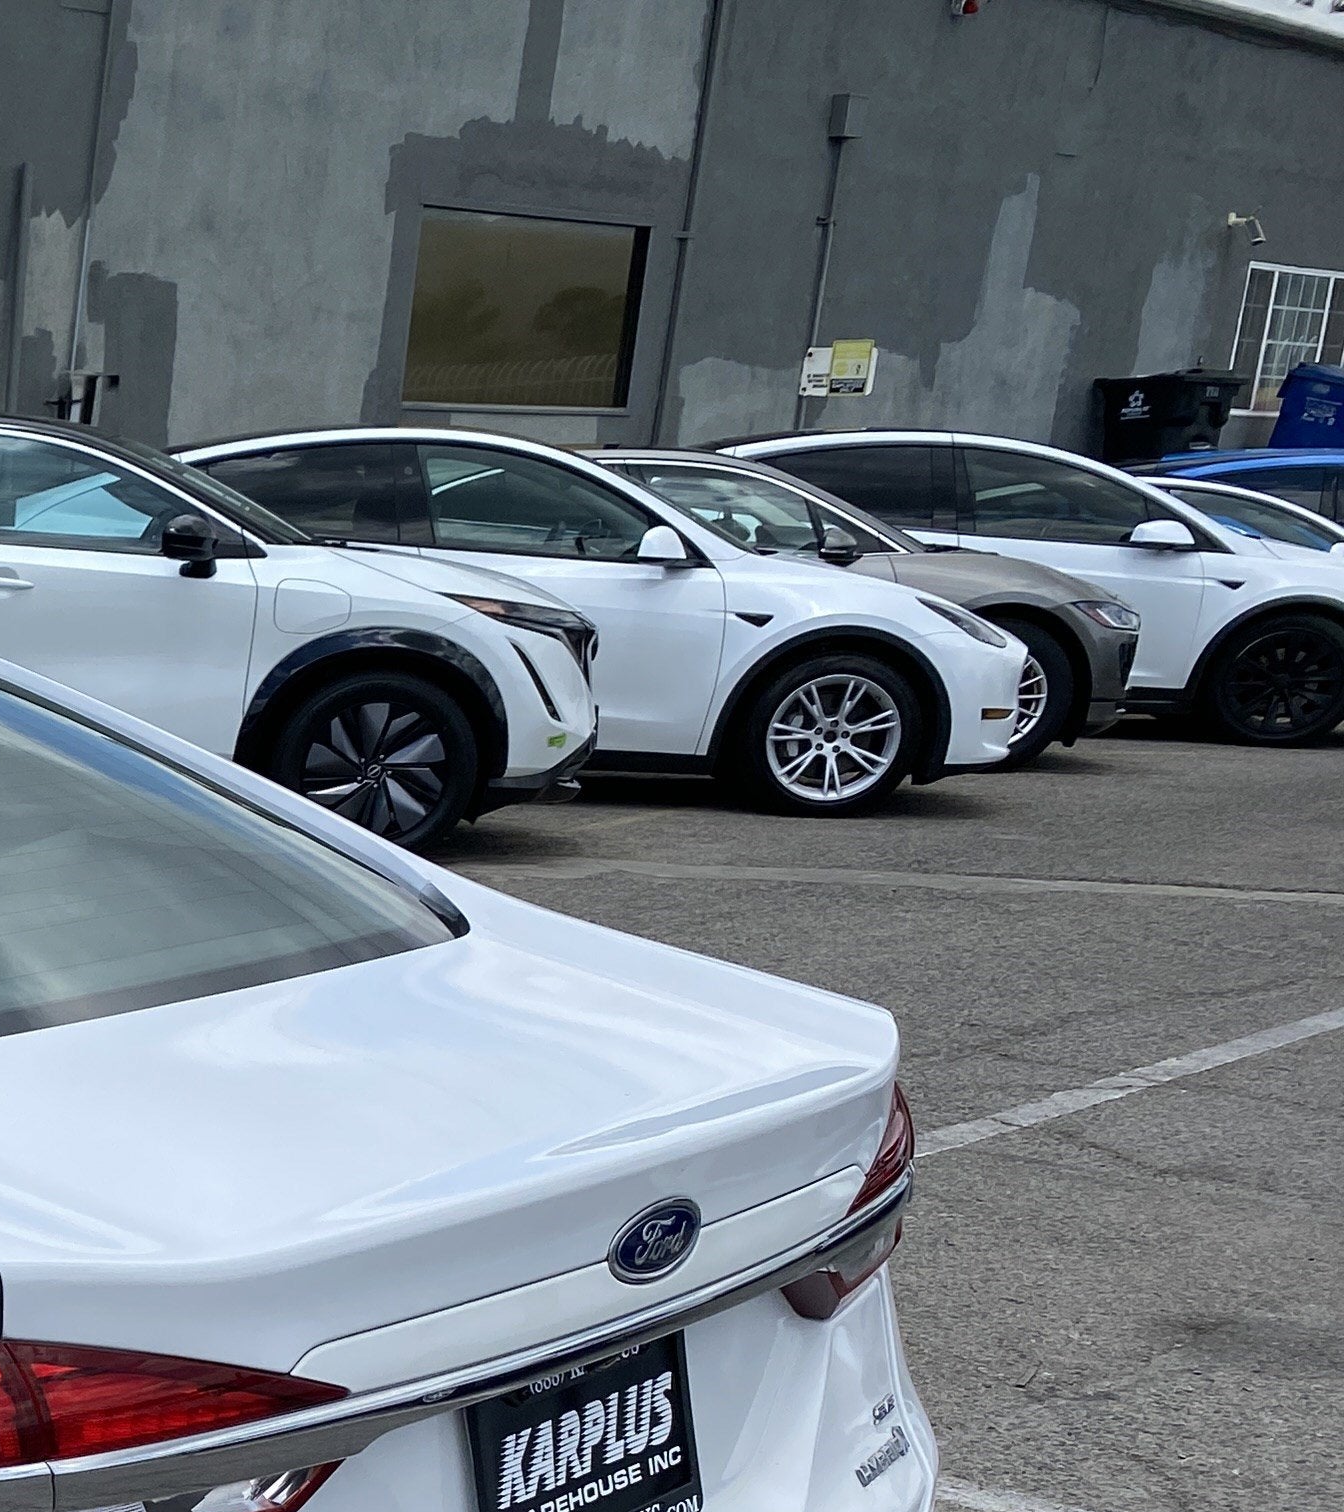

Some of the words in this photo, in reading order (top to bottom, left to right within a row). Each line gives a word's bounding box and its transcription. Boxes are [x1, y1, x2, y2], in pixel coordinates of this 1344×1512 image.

[635, 1215, 687, 1265] Ford
[497, 1371, 672, 1510] KARPLUS
[648, 1446, 682, 1476] INC
